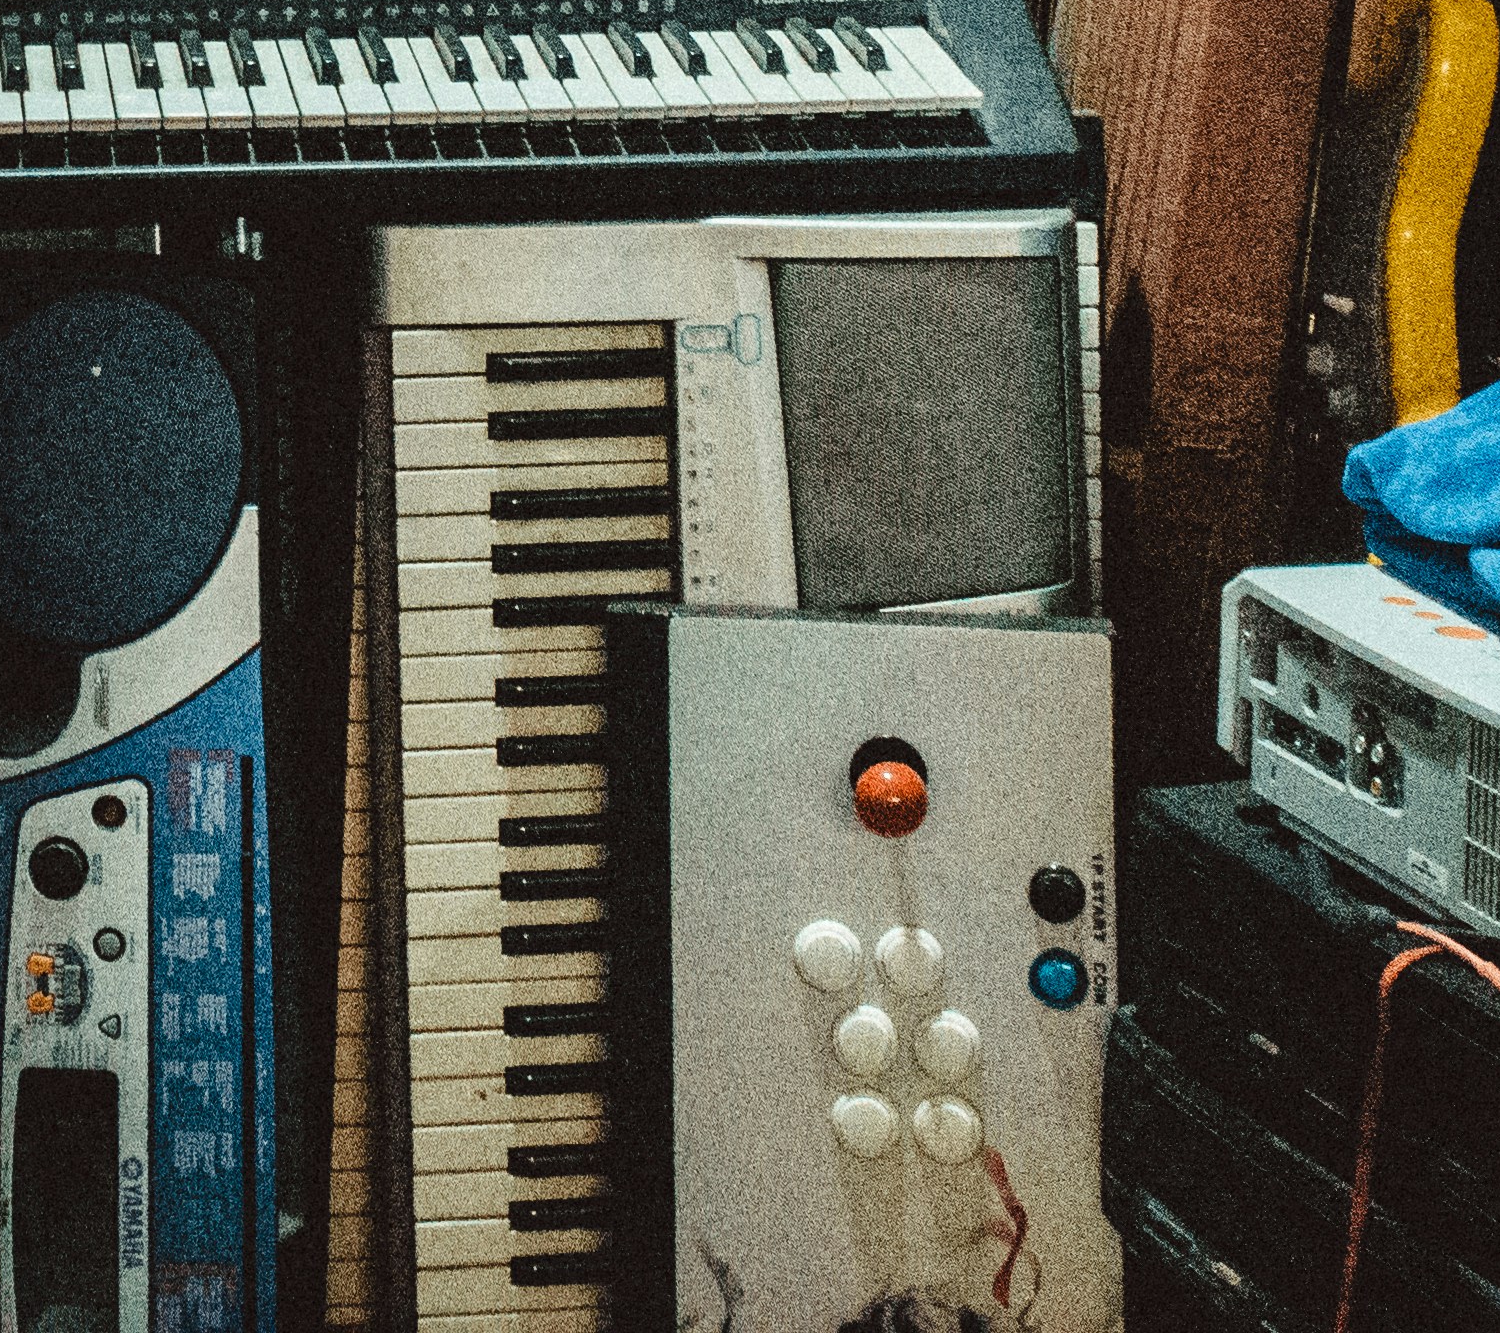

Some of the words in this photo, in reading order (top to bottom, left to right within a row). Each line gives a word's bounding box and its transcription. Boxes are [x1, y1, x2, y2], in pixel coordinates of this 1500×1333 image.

[1092, 852, 1105, 876] 1P
[1091, 881, 1106, 944] START
[1092, 962, 1108, 1006] COIN
[121, 1184, 144, 1270] YAMAHA
